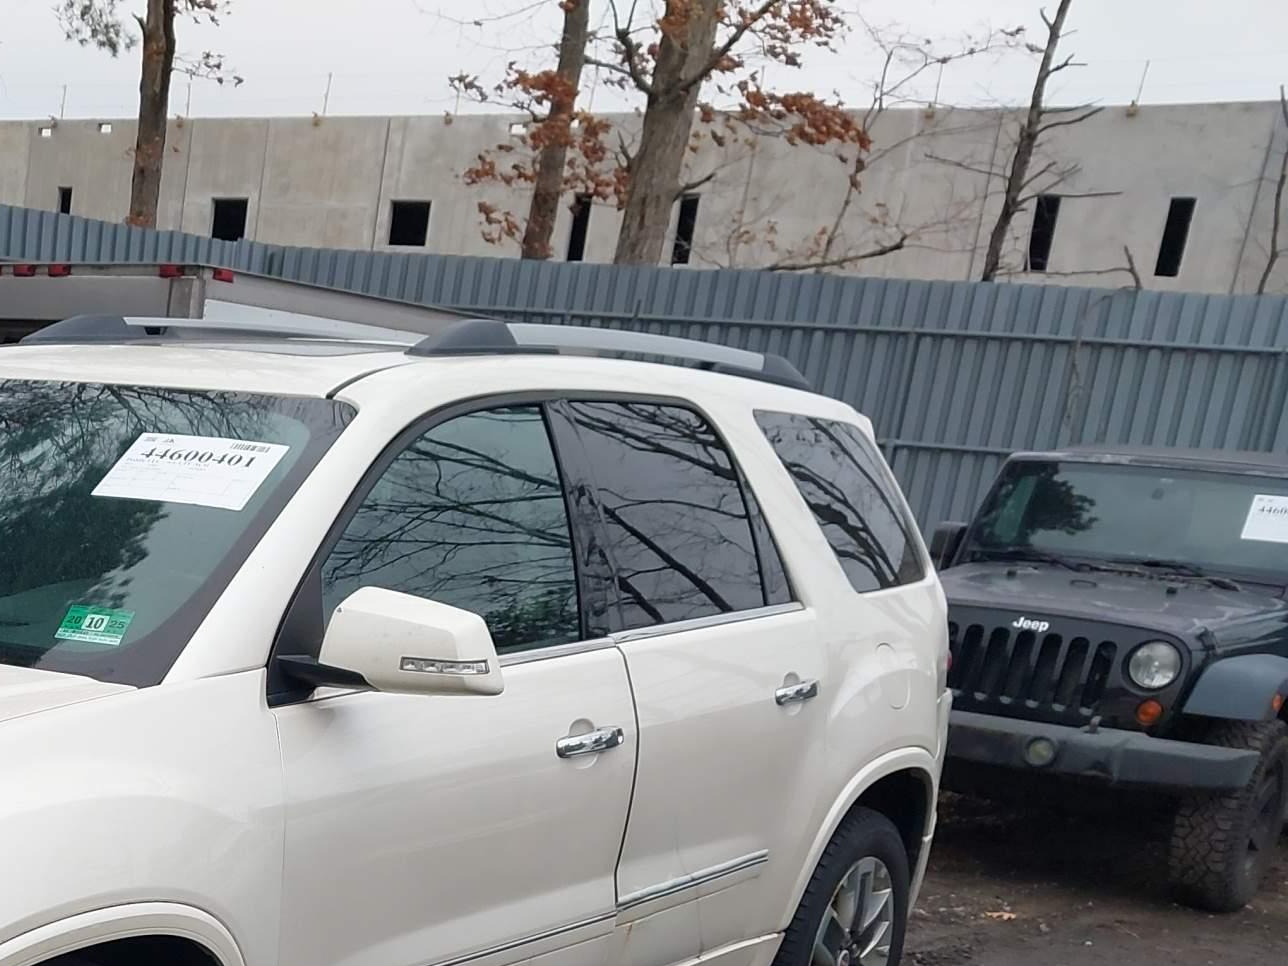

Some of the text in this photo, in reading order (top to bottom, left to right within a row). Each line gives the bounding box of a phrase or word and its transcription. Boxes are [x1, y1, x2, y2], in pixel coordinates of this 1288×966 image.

[141, 446, 258, 468] 44600401
[85, 616, 105, 630] 10
[108, 619, 126, 629] 25
[1012, 616, 1049, 632] Jeep
